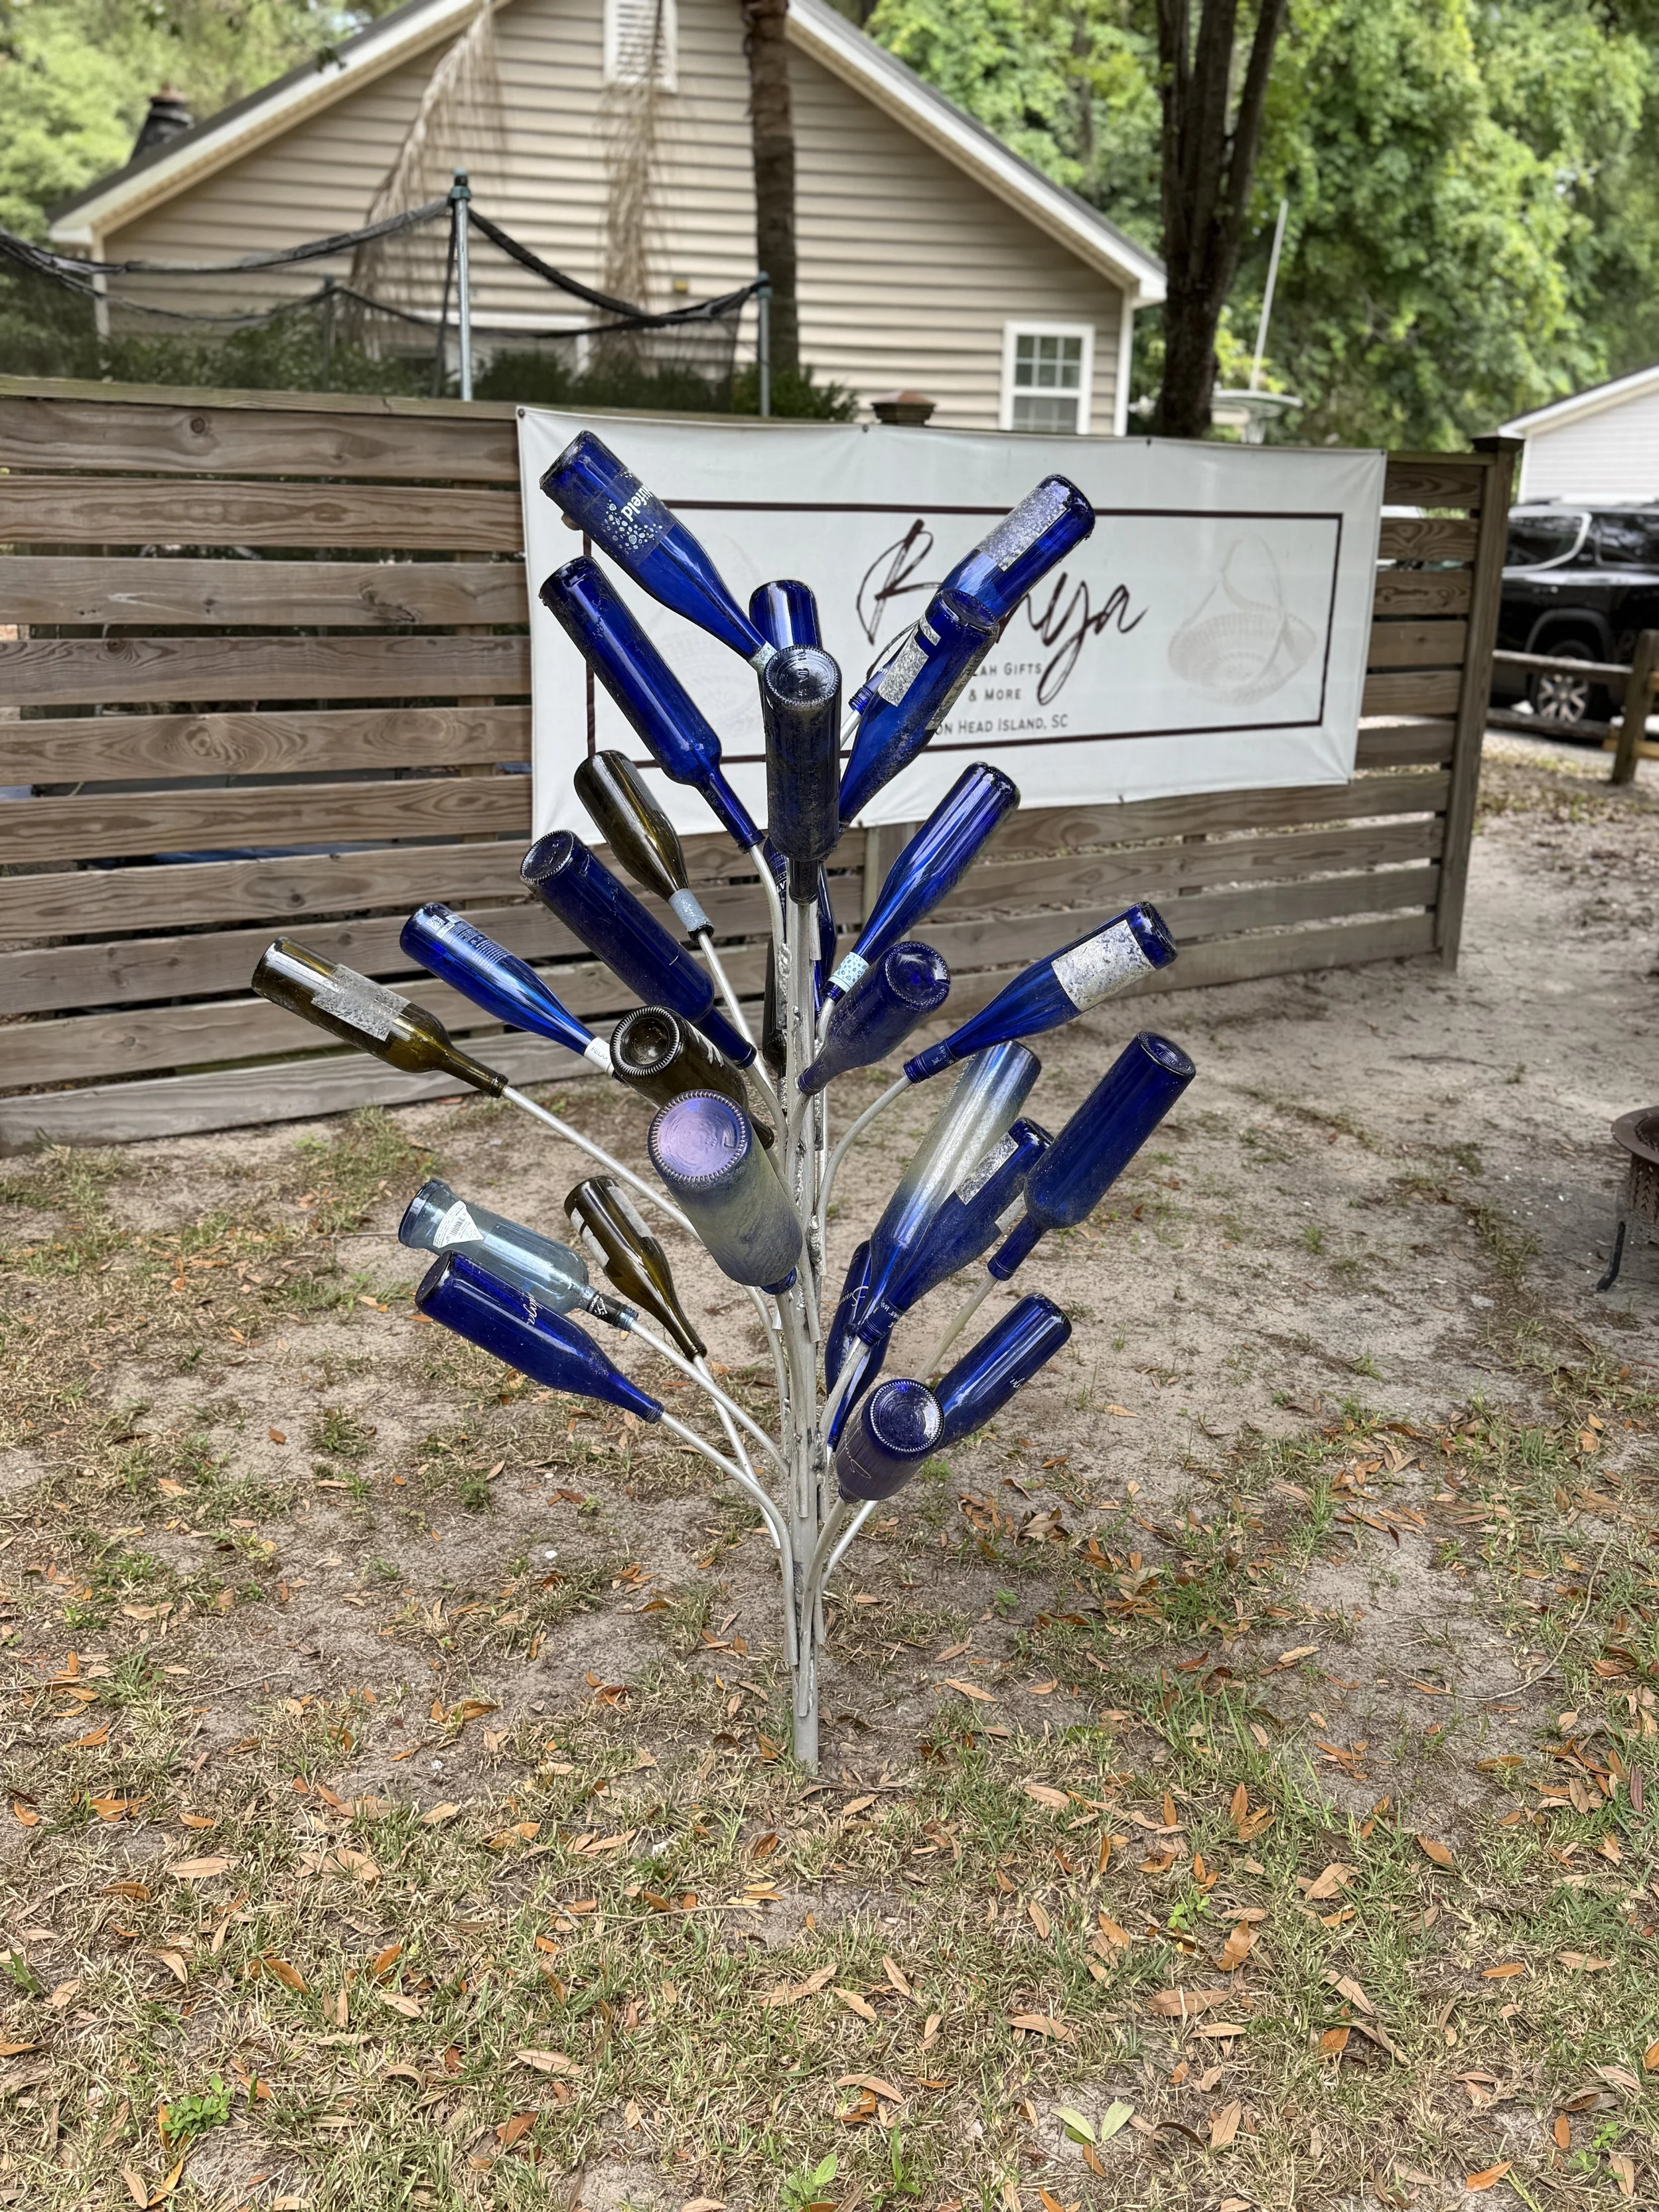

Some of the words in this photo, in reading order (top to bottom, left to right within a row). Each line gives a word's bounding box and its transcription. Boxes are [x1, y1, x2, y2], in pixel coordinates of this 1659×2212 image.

[620, 485, 653, 522] lüfeld
[969, 688, 977, 702] &
[1051, 713, 1068, 728] SC
